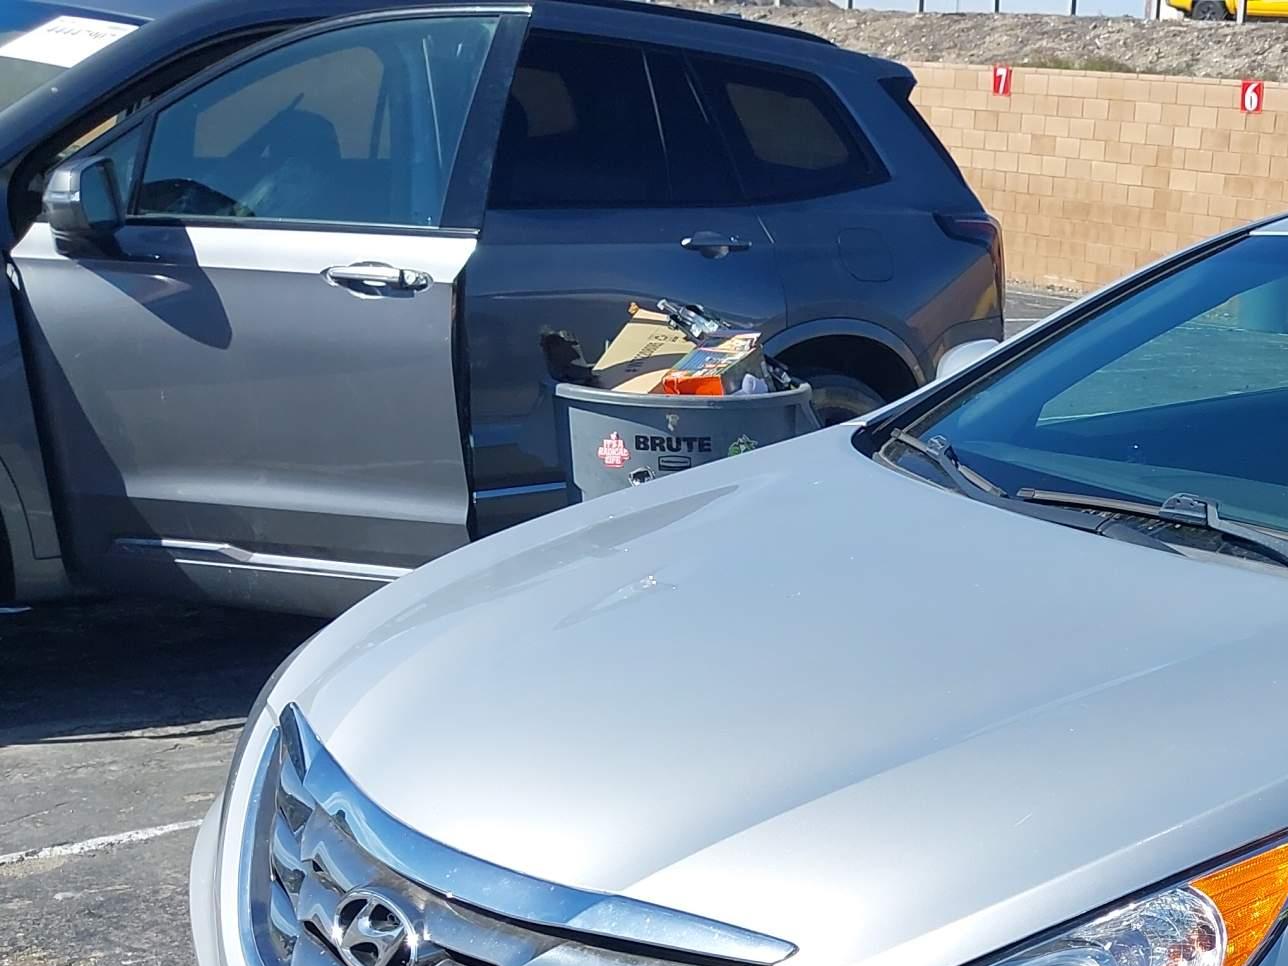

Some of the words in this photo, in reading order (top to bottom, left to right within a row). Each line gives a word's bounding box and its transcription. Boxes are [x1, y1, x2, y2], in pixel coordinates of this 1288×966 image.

[995, 69, 1008, 94] 7
[1244, 82, 1258, 111] 6
[635, 435, 712, 453] BRUTE
